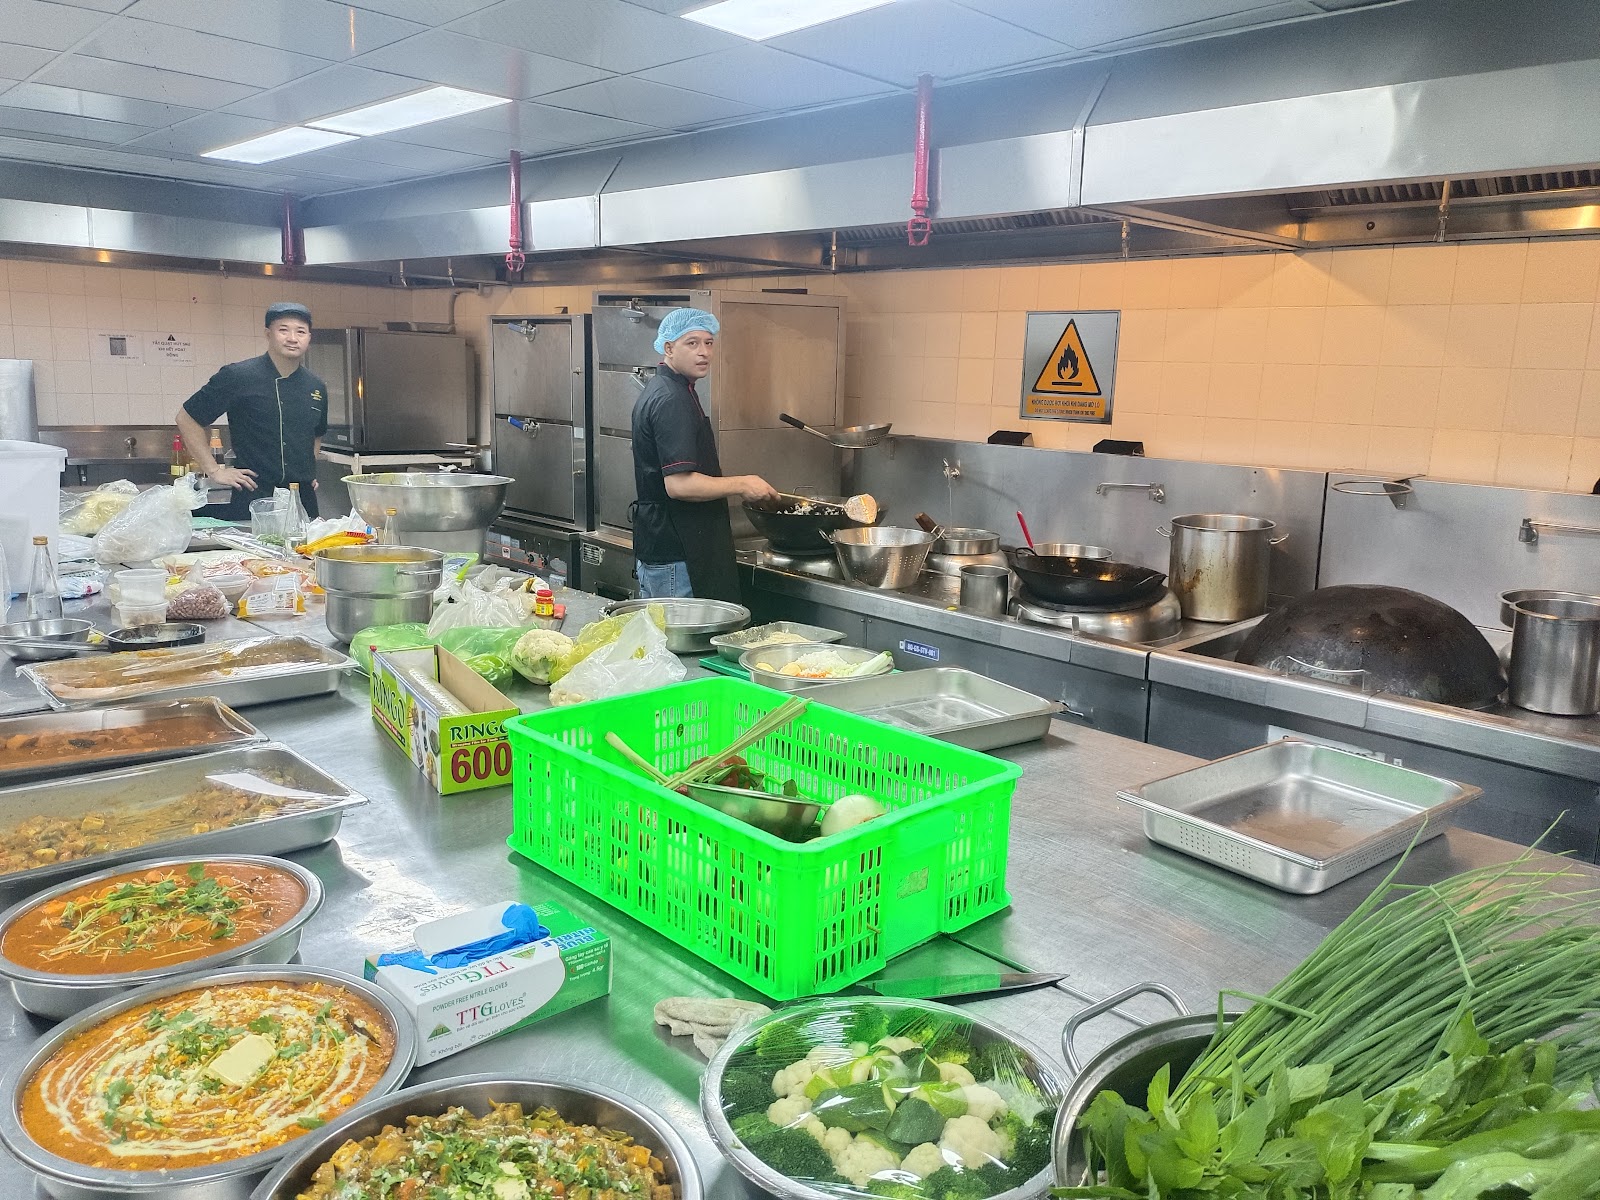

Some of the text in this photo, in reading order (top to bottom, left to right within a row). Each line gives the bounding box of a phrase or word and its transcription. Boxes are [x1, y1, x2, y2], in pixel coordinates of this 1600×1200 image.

[372, 671, 405, 729] RINGO
[451, 742, 512, 783] 600
[541, 926, 597, 948] NITRILE
[559, 935, 595, 951] BLUE
[432, 981, 508, 1012] POWDER FREE NITRILE GLOVES
